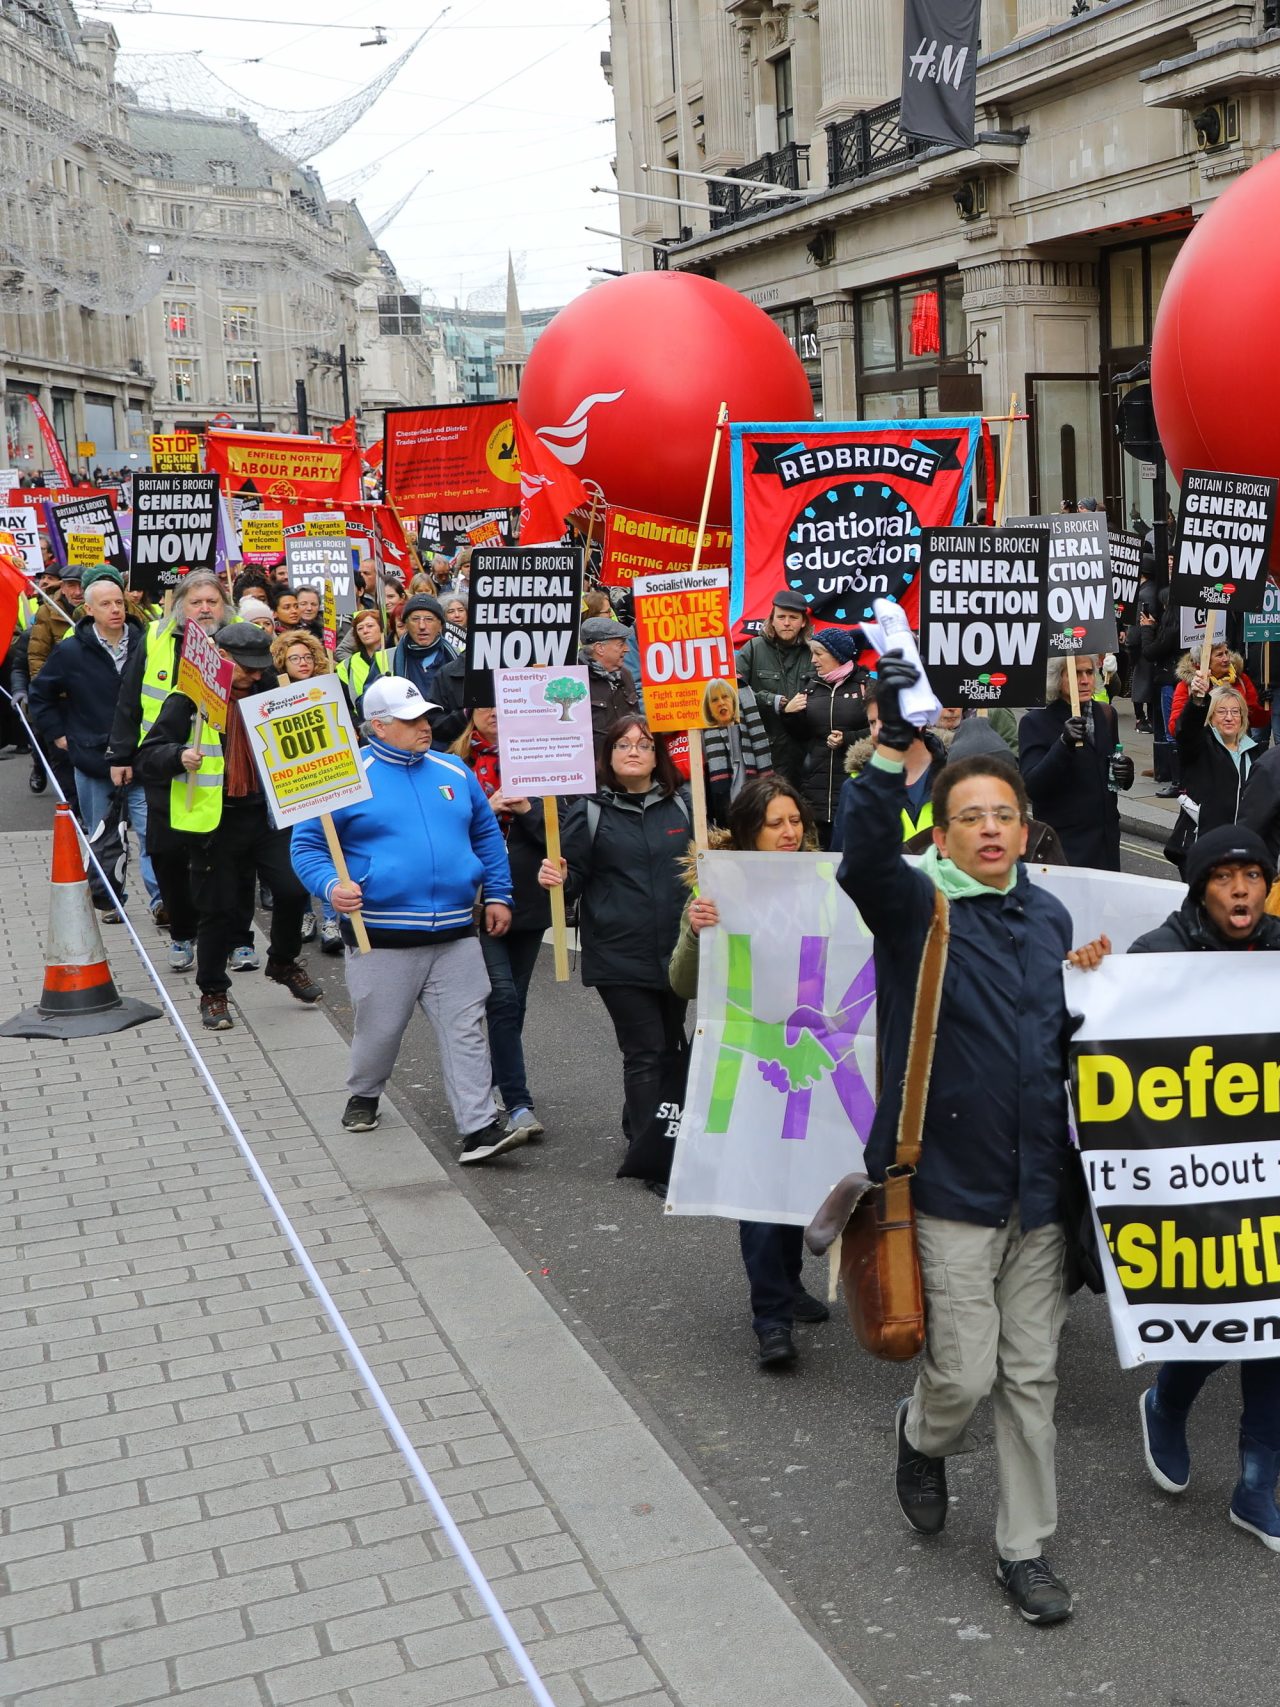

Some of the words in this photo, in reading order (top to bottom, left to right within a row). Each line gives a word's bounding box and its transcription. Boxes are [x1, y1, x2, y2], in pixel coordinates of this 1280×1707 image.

[909, 37, 969, 90] H&M
[152, 437, 197, 452] STOP
[156, 454, 196, 464] PICKING
[160, 463, 173, 471] ON
[174, 463, 192, 471] THE
[247, 451, 287, 461] ENFIELD
[289, 454, 323, 464] NORTH
[780, 447, 935, 482] REDBRIDGE
[231, 461, 289, 477] LABOUR
[292, 465, 339, 479] PARTY
[138, 479, 170, 491] BRITAIN
[172, 479, 181, 490] IS
[182, 479, 214, 490] BROKEN
[1188, 477, 1223, 493] BRITAIN
[1224, 480, 1234, 494] IS
[1235, 482, 1271, 497] BROKEN
[138, 494, 213, 511] GENERAL
[1185, 494, 1268, 520] GENERAL
[138, 513, 212, 531] ELECTION
[247, 521, 279, 531] Migrants
[310, 522, 341, 531] Migrants
[796, 511, 913, 545] national
[1052, 521, 1062, 535] IS
[1064, 519, 1100, 533] BROKEN
[1183, 516, 1265, 543] ELECTION
[72, 535, 100, 544] Migrants
[136, 532, 213, 564] NOW
[930, 536, 976, 553] BRITAIN
[980, 536, 991, 553] IS
[995, 537, 1040, 554] BROKEN
[291, 549, 348, 561] GENERAL
[478, 556, 519, 570] BRITAIN
[521, 556, 531, 570] IS
[535, 556, 574, 570] BROKEN
[785, 539, 922, 571] education
[1178, 540, 1265, 581] NOW
[929, 558, 1039, 584] GENERAL
[476, 576, 573, 597] GENERAL
[645, 577, 684, 593] Socialist
[683, 576, 718, 588] Worker
[640, 594, 682, 617] KICK
[686, 590, 722, 611] THE
[929, 590, 1038, 615] ELECTION
[1047, 585, 1107, 623] OW
[475, 603, 572, 624] ELECTION
[643, 611, 725, 642] TORIES
[473, 630, 573, 670] NOW
[928, 621, 1041, 667] NOW
[646, 636, 730, 683] OUT!
[502, 673, 547, 682] Austerity:
[268, 693, 305, 708] Socialist
[654, 700, 668, 709] and
[670, 698, 700, 708] austerity
[676, 688, 698, 698] racism
[267, 702, 293, 714] Party
[676, 710, 700, 720] Corbyn
[273, 709, 324, 736] TORIES
[280, 725, 328, 759] OUT
[272, 769, 294, 782] END
[296, 750, 350, 775] AUSTERITY
[275, 781, 292, 789] mass
[293, 773, 318, 784] working
[318, 767, 334, 775] class
[334, 761, 354, 771] action
[284, 787, 294, 795] for
[300, 778, 324, 790] General
[324, 770, 349, 781] Election
[511, 773, 584, 786] gimms.org.uk
[281, 784, 362, 815] www.socialistparty.org.uk
[1089, 1157, 1151, 1192] It's
[1169, 1152, 1267, 1190] about
